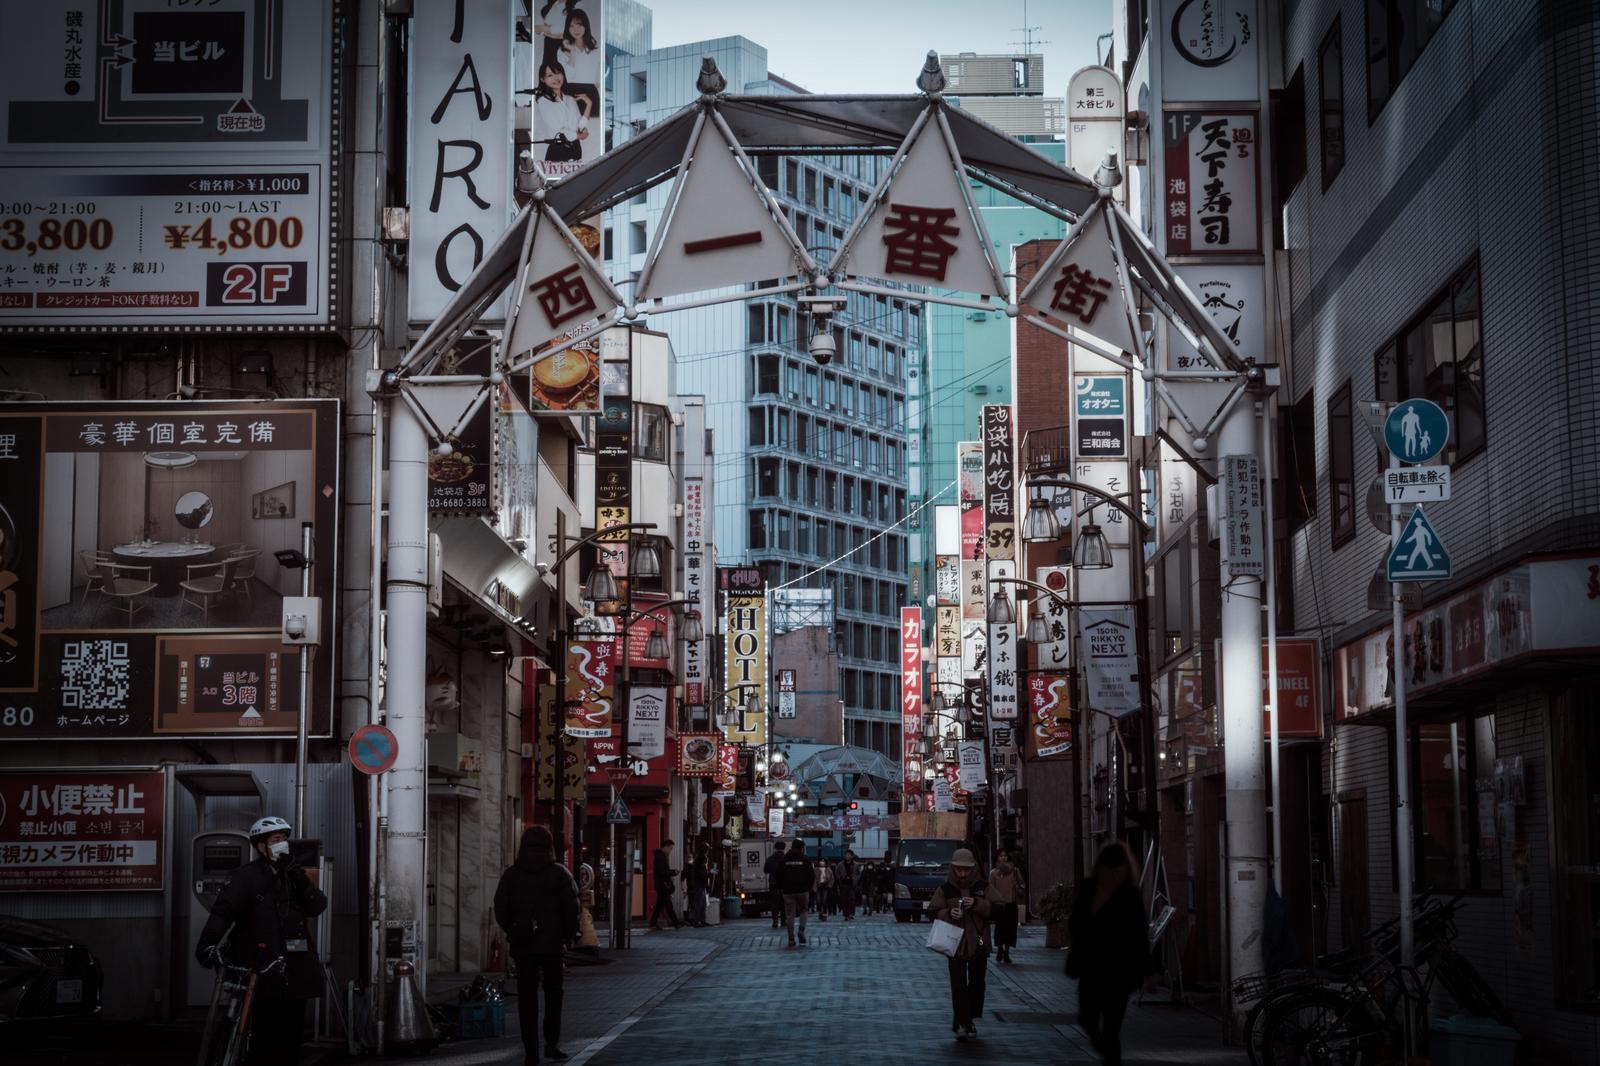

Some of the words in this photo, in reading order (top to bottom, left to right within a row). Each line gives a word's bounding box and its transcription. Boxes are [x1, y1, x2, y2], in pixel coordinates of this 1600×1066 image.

[64, 11, 84, 79] 磯丸水産
[153, 41, 225, 63] 当ビル
[1086, 88, 1104, 97] 第三
[1077, 100, 1114, 109] 大谷ビル
[219, 115, 263, 130] 現在地
[1168, 114, 1191, 140] 1F
[1233, 128, 1253, 158] 廻る
[1196, 119, 1232, 244] 天下寿司
[1170, 178, 1187, 239] 池袋店
[0, 218, 113, 256] 3,800
[164, 217, 303, 256] ¥4,800
[222, 264, 293, 304] 2F
[1082, 399, 1120, 409] オオタニ
[79, 421, 275, 447] 豪華個室完備
[1082, 438, 1121, 449] 三和商会
[1077, 465, 1091, 476] 1F
[1388, 471, 1446, 485] 自転車を除く
[468, 483, 486, 495] 3F
[1237, 459, 1251, 558] 防犯カメラ作動中
[1091, 644, 1126, 653] NEXT
[223, 671, 259, 684] 当ビル
[734, 608, 759, 732] HOTEL
[222, 685, 257, 705] 3階
[1032, 678, 1045, 706] 迎春
[57, 714, 130, 727] ホームページ
[19, 784, 145, 817] 小便禁止
[19, 821, 78, 836] 禁止小便
[0, 844, 134, 863] 視カメラ作動中
